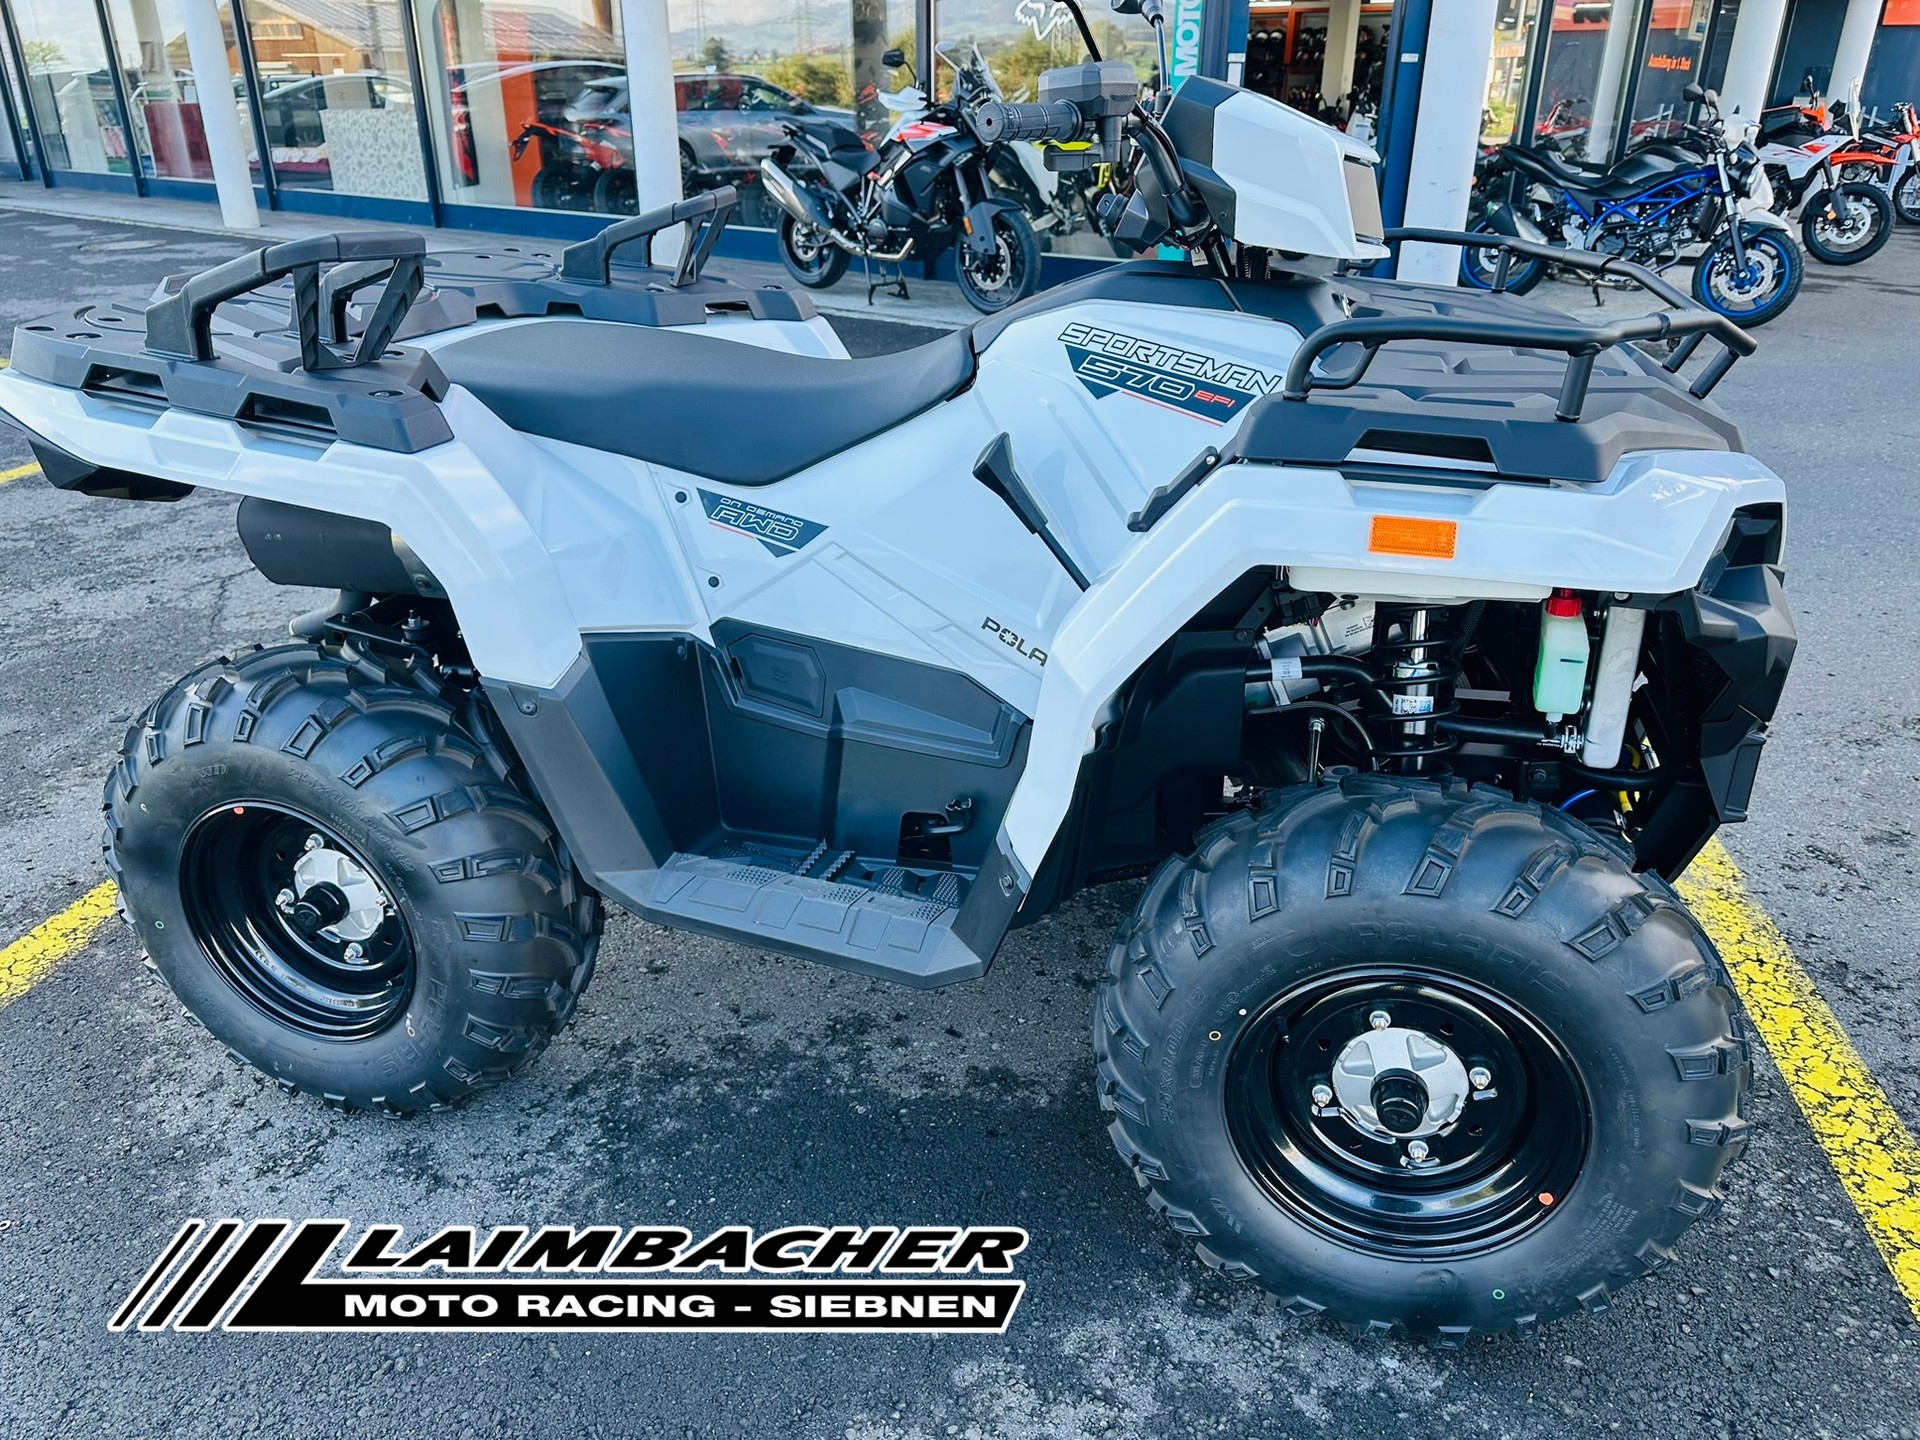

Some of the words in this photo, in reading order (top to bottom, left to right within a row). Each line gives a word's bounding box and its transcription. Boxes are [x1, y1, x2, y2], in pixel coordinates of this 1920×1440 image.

[1057, 322, 1283, 394] SPORTSMAN
[1077, 355, 1196, 401] 570
[1194, 390, 1236, 408] EFI
[711, 505, 799, 541] AWD
[720, 497, 741, 508] ON
[746, 505, 804, 527] DEMAND
